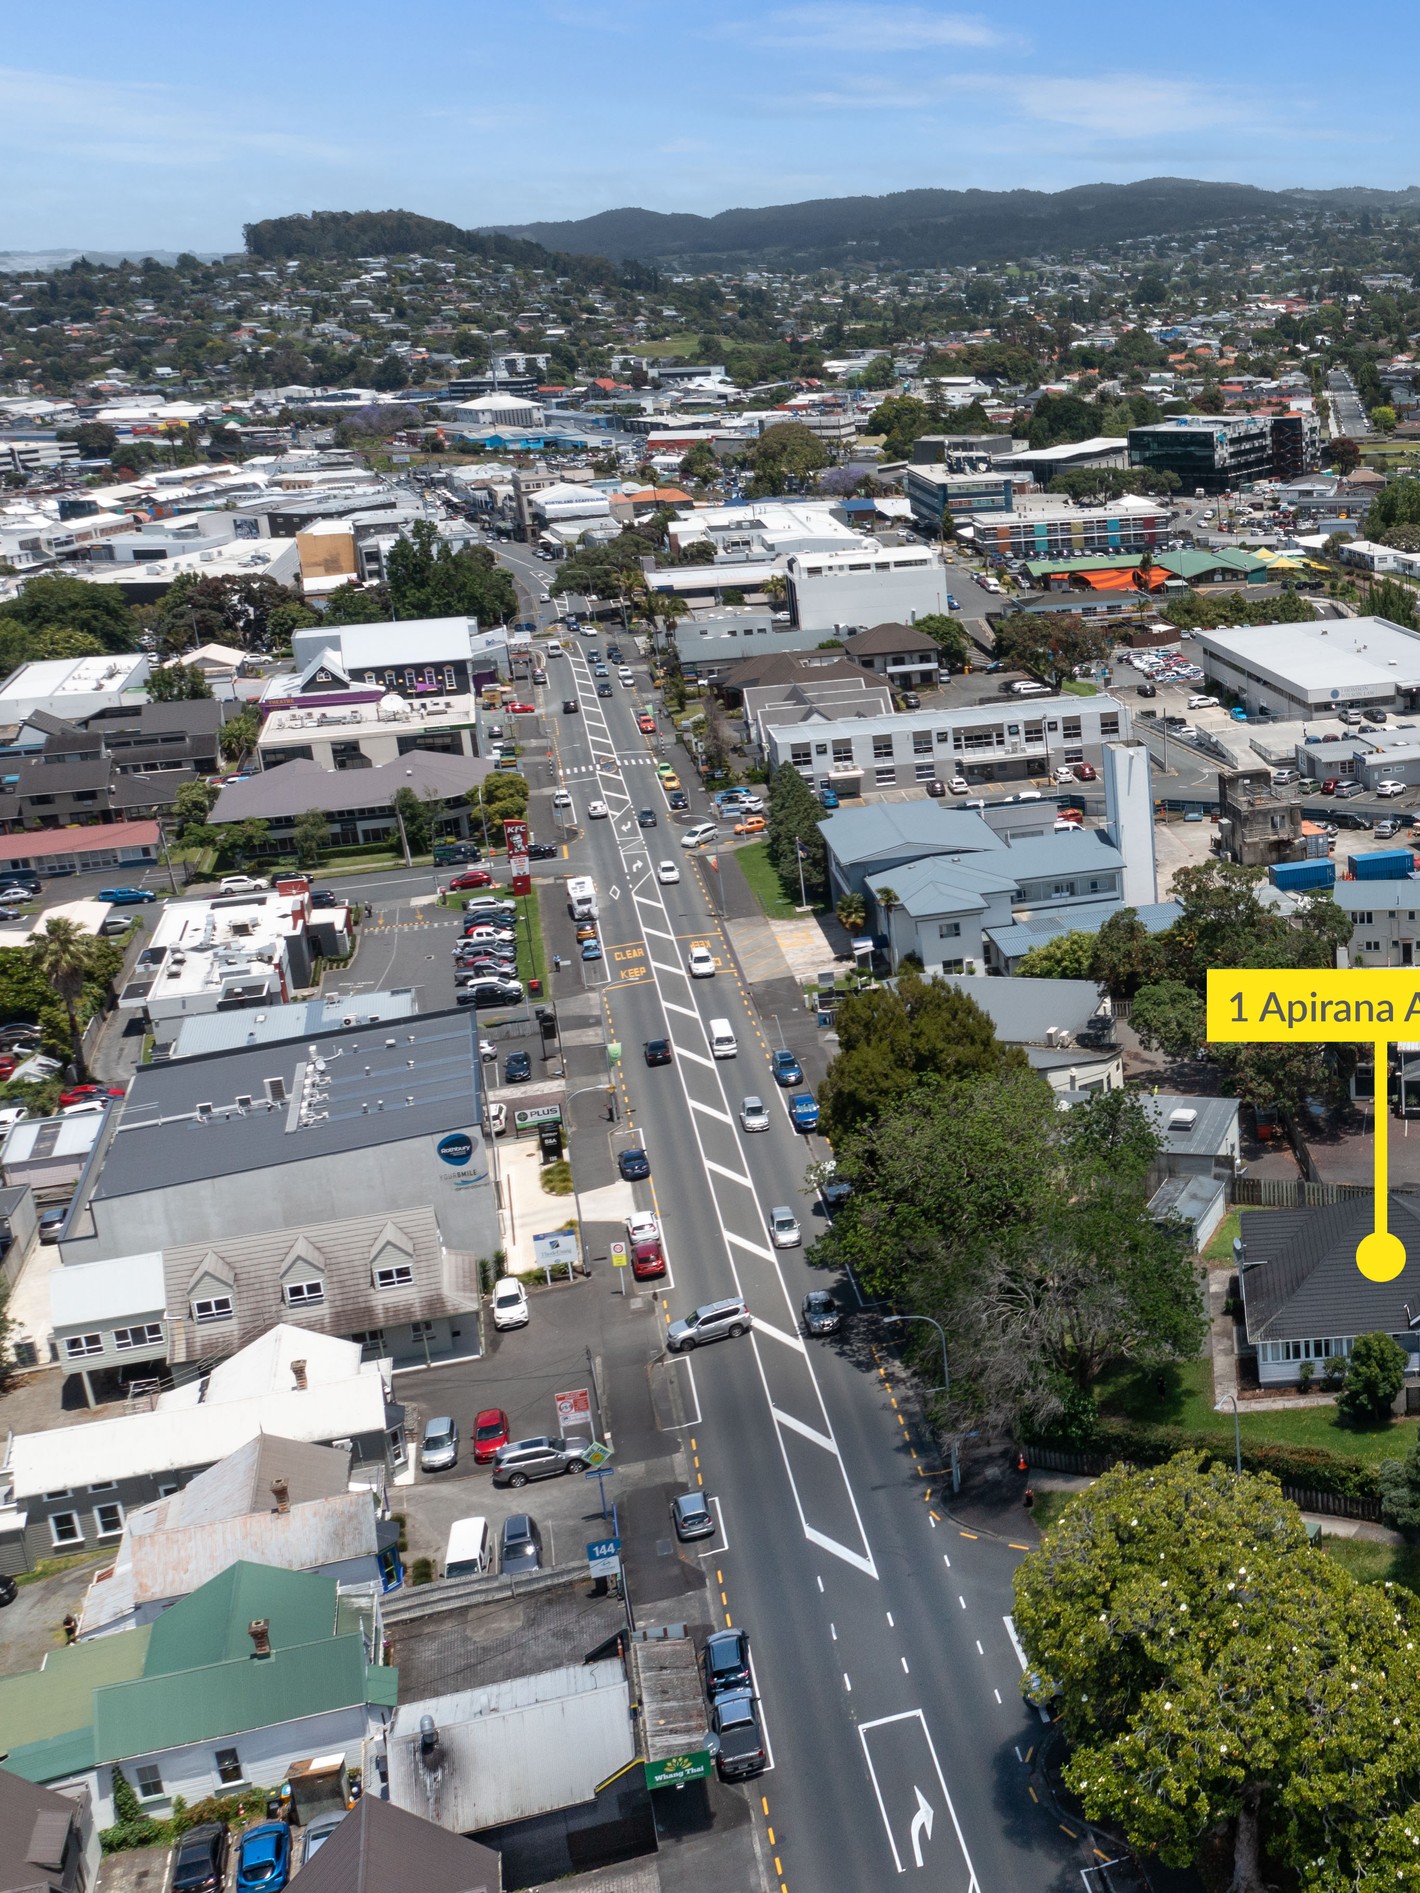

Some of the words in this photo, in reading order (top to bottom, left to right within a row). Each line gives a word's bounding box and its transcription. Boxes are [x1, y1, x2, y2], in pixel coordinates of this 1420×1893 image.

[507, 825, 527, 834] KFC
[614, 948, 645, 961] CLEAR
[620, 966, 647, 980] KEEP
[530, 1107, 558, 1118] PLUS
[441, 1145, 471, 1154] Rothbury
[592, 1543, 616, 1557] 144
[654, 1771, 684, 1782] Whang
[685, 1765, 704, 1775] Thai
